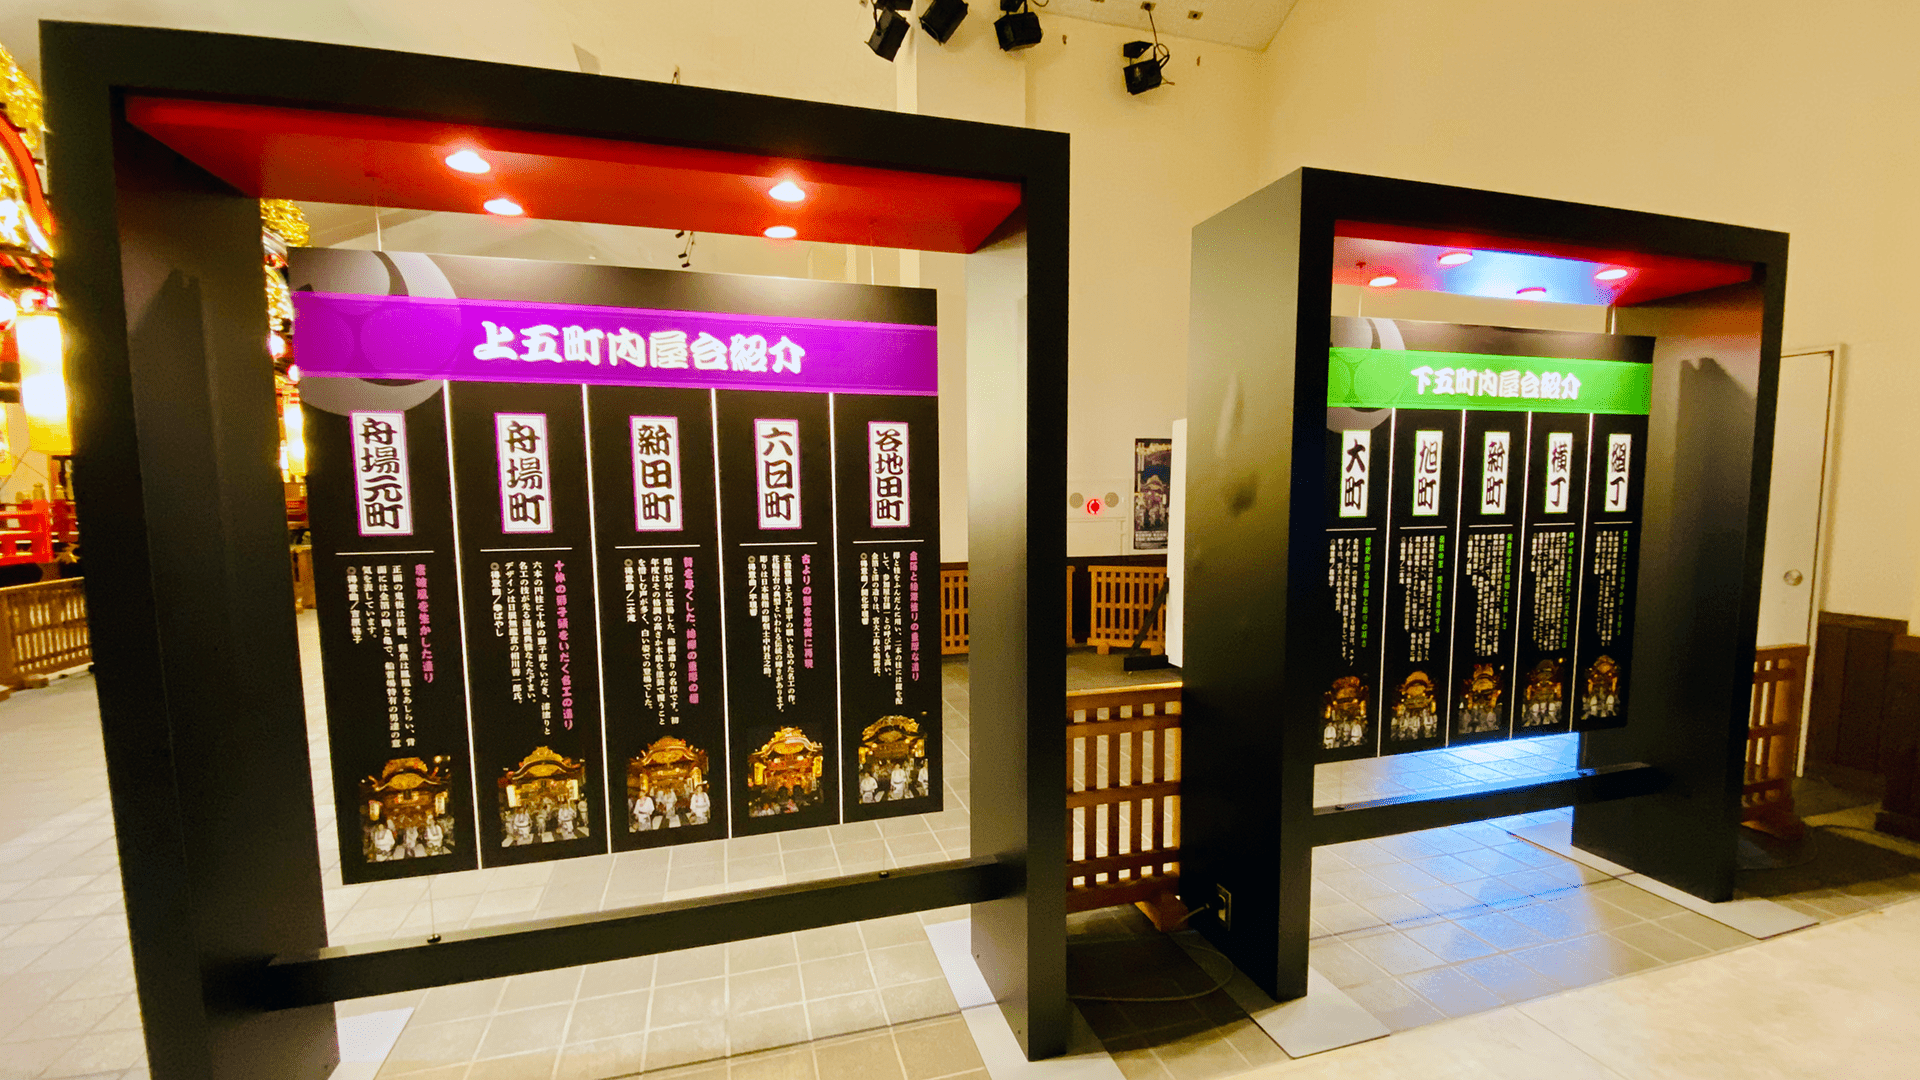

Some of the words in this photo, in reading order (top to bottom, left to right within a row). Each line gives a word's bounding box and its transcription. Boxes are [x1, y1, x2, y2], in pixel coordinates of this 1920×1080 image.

[473, 321, 805, 374] 上五町内屋台紹介
[1411, 365, 1581, 400] 下五町内屋台紹介
[361, 417, 404, 529] 舟場元町
[504, 420, 545, 525] 舟場町
[638, 424, 674, 524] 新田町
[762, 426, 796, 522] 六日町
[876, 428, 904, 521] 谷地田町
[1344, 439, 1367, 509] 大町
[1417, 442, 1438, 509] 旭町
[1485, 441, 1504, 508] 新町
[1550, 442, 1568, 507] 横丁
[554, 560, 573, 730] 十体の獅子頭をいだく名工の造り
